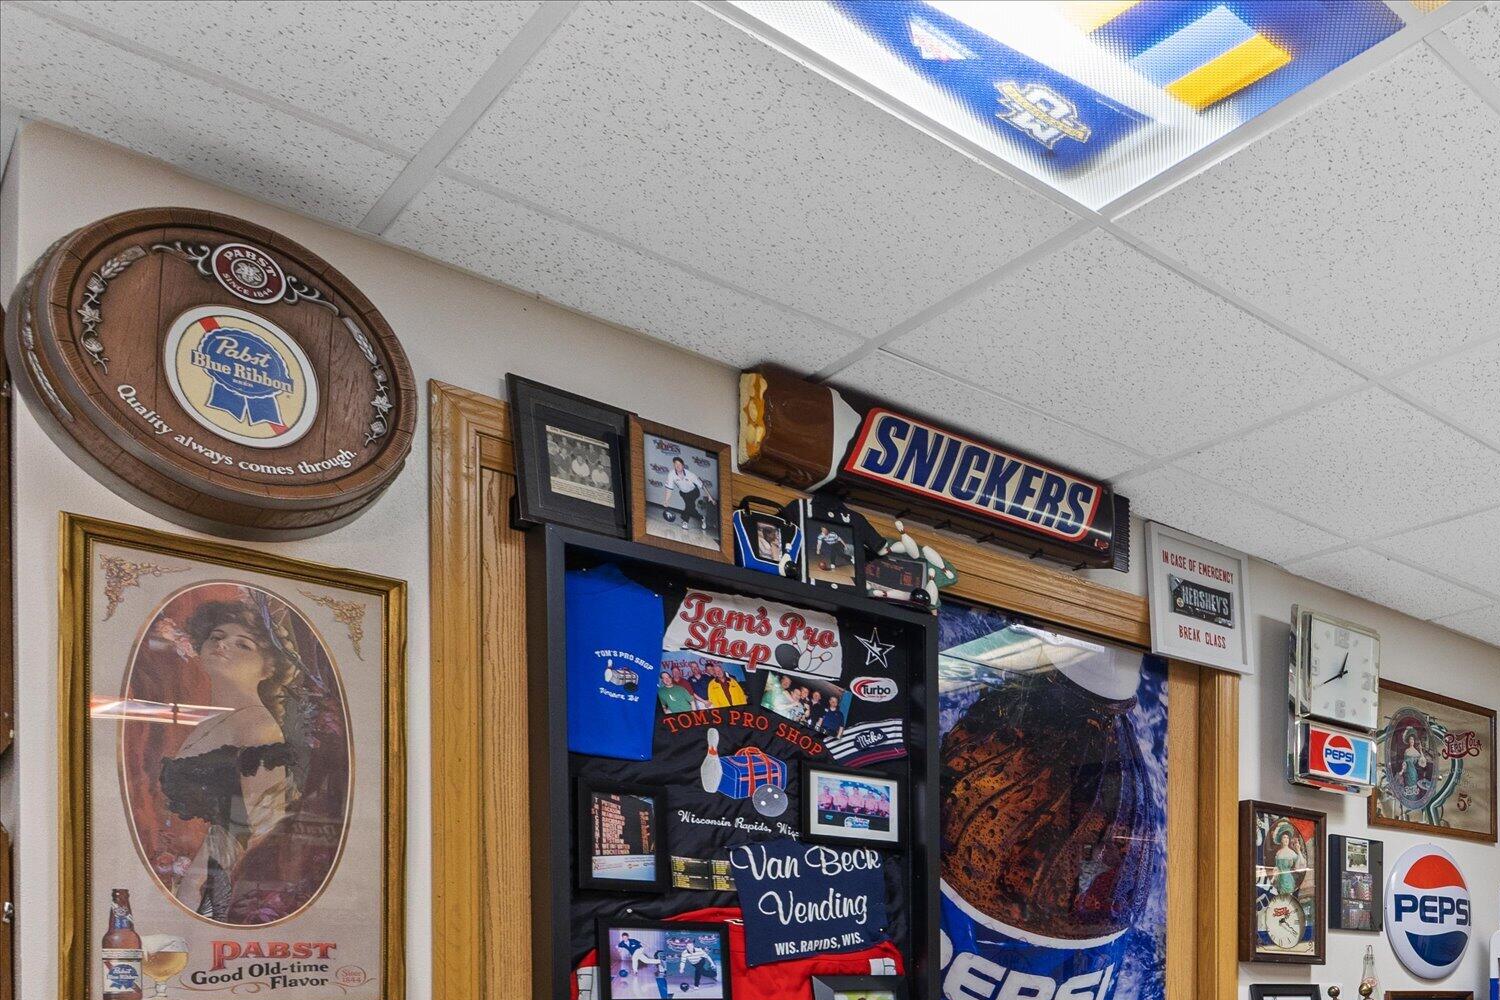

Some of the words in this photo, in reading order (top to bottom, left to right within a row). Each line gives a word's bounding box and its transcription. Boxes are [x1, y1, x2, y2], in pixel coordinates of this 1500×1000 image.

[223, 249, 277, 277] PABST
[222, 273, 250, 296] SINCE
[215, 335, 272, 368] Pabst
[193, 350, 232, 375] Blue
[234, 362, 292, 393] Ribbon
[117, 383, 172, 438] Quality
[174, 433, 234, 467] always
[238, 458, 295, 476] comes
[299, 448, 358, 476] through.
[861, 414, 1094, 536] SNICKERS
[1162, 550, 1169, 564] IN
[1170, 553, 1187, 570] CASE
[1188, 559, 1197, 573] OF
[1198, 562, 1234, 585] EMERGENCY
[1181, 584, 1229, 616] HERSHEY'S
[679, 592, 772, 637] Tom's
[775, 611, 838, 650] Pro
[1178, 624, 1201, 643] BREAK
[619, 651, 635, 661] PRO
[634, 656, 654, 671] SHOP
[684, 620, 772, 672] Shop
[862, 684, 891, 695] Turbo
[728, 710, 769, 731] PRO
[775, 722, 823, 756] SHOP
[857, 730, 884, 749] Mike
[1325, 747, 1355, 764] PEPSI
[678, 810, 732, 828] Wisconsin
[734, 817, 772, 834] Rapids,
[729, 844, 800, 881] Van
[758, 888, 868, 926] Vending
[1394, 893, 1472, 927] PEPSI
[208, 940, 337, 972] PABST
[774, 941, 800, 956] WIS.
[799, 936, 841, 953] RAPIDS,
[842, 932, 864, 947] WIS.
[191, 964, 244, 985] Good
[248, 961, 329, 978] Old-time
[270, 975, 329, 990] Flavor
